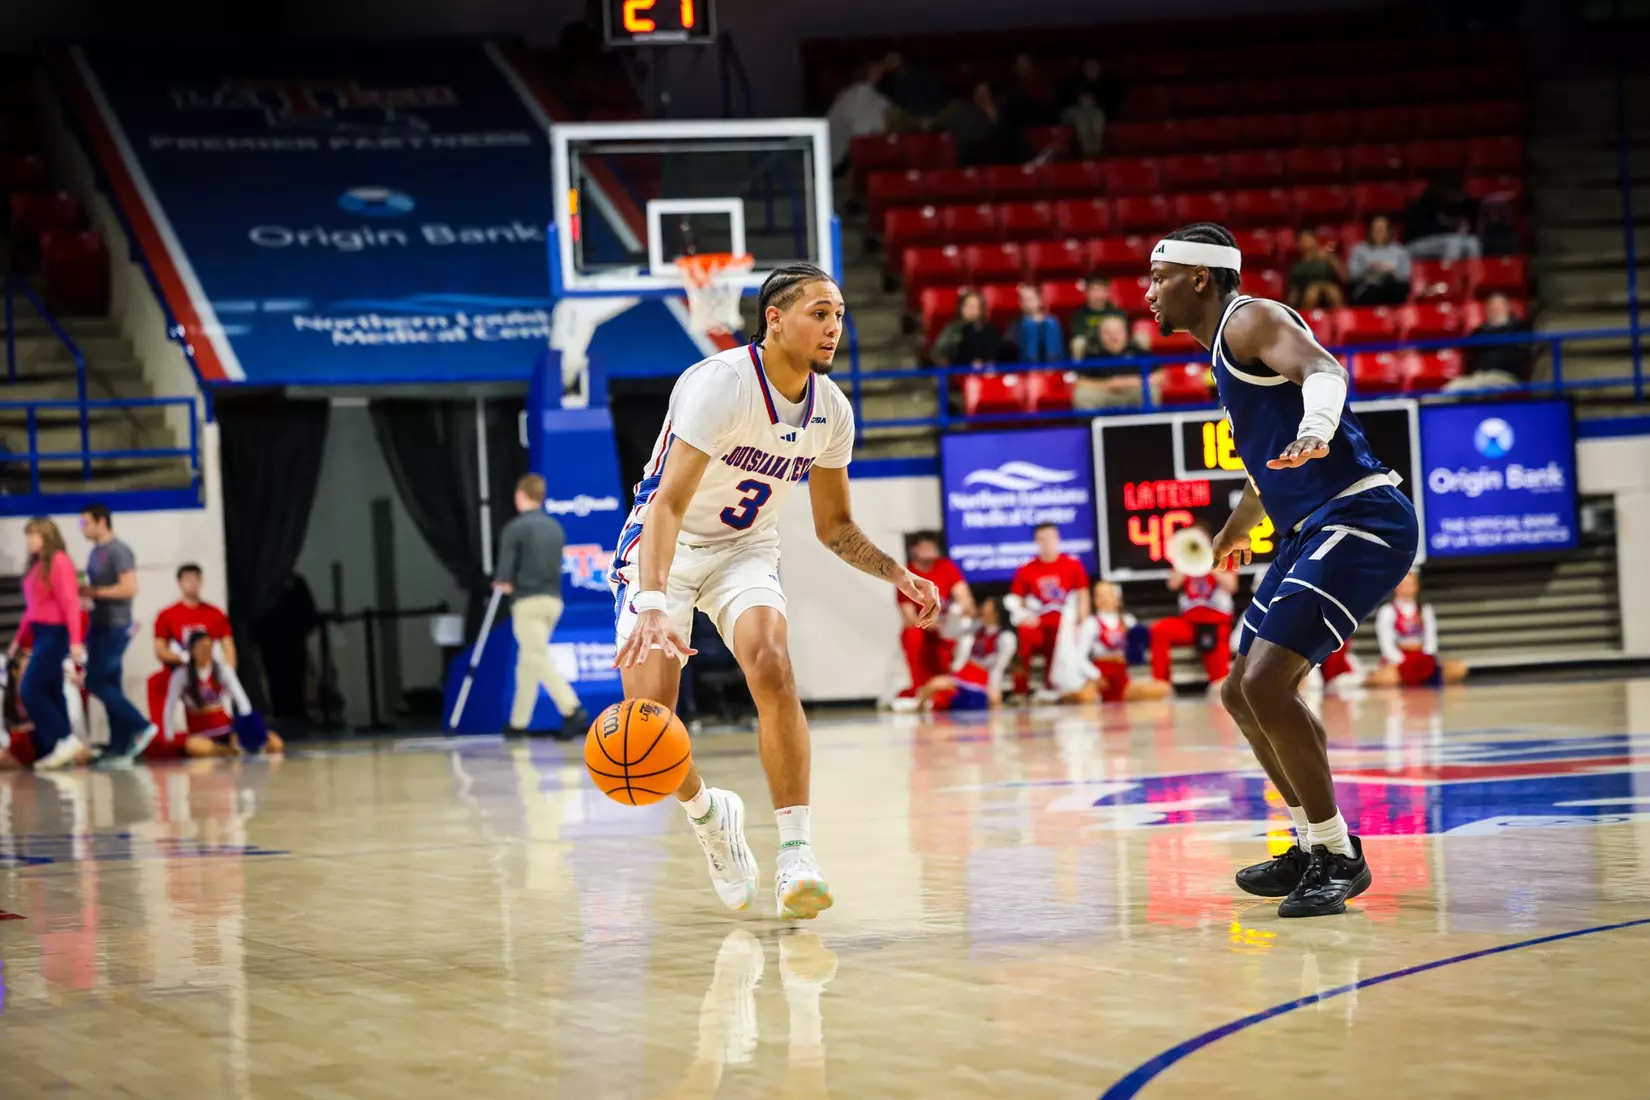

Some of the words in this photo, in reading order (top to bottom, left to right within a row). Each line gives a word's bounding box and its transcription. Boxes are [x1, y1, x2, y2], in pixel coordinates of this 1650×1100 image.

[148, 134, 318, 151] PREMIER
[327, 129, 531, 149] PARTNERS
[249, 225, 409, 251] Origin
[420, 220, 544, 245] Bank
[293, 311, 448, 332] Northern
[332, 326, 468, 346] Medical
[1428, 467, 1504, 498] Origin
[1506, 462, 1565, 490] Bank
[719, 478, 773, 530] 3
